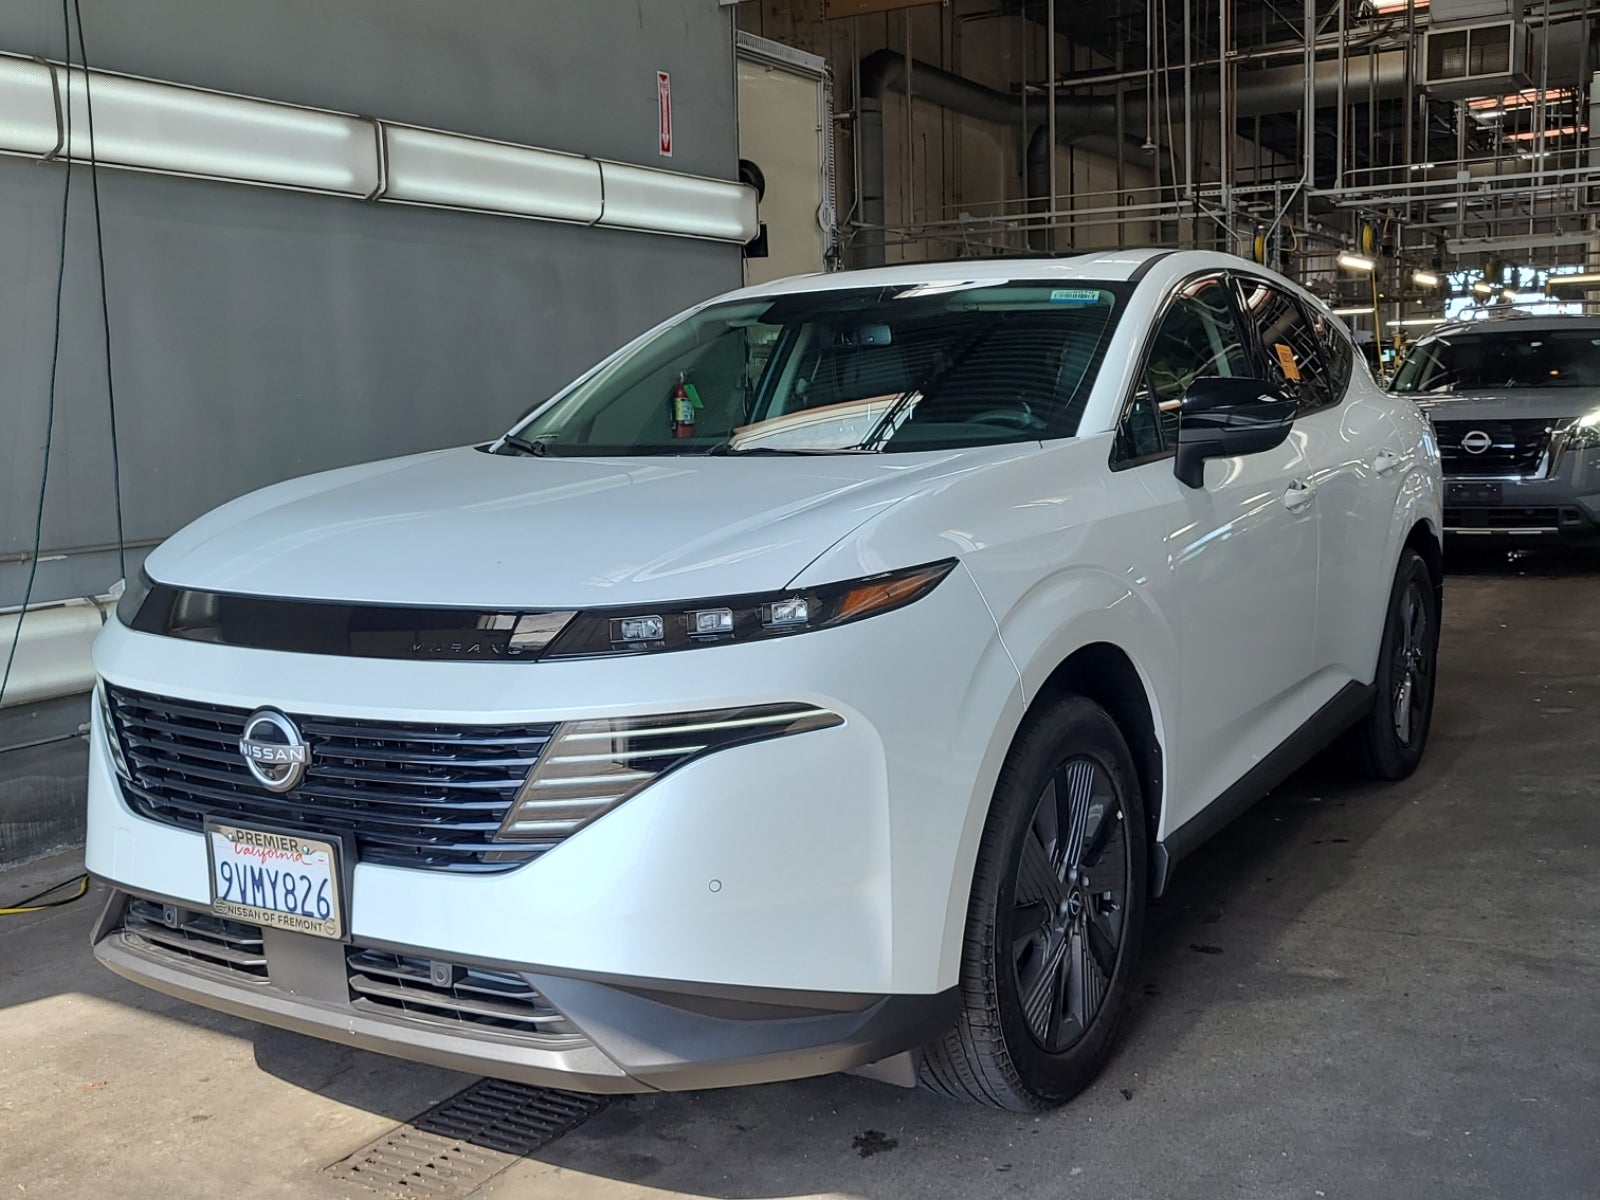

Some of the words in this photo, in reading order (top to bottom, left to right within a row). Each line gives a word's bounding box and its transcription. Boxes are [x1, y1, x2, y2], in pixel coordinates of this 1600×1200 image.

[239, 740, 303, 761] NISSAN
[235, 830, 299, 852] PREMIER
[234, 842, 312, 865] California
[220, 861, 331, 920] 9VMY826
[228, 906, 260, 920] NISSAN
[263, 912, 275, 922] OF
[278, 914, 323, 932] FREMONT
